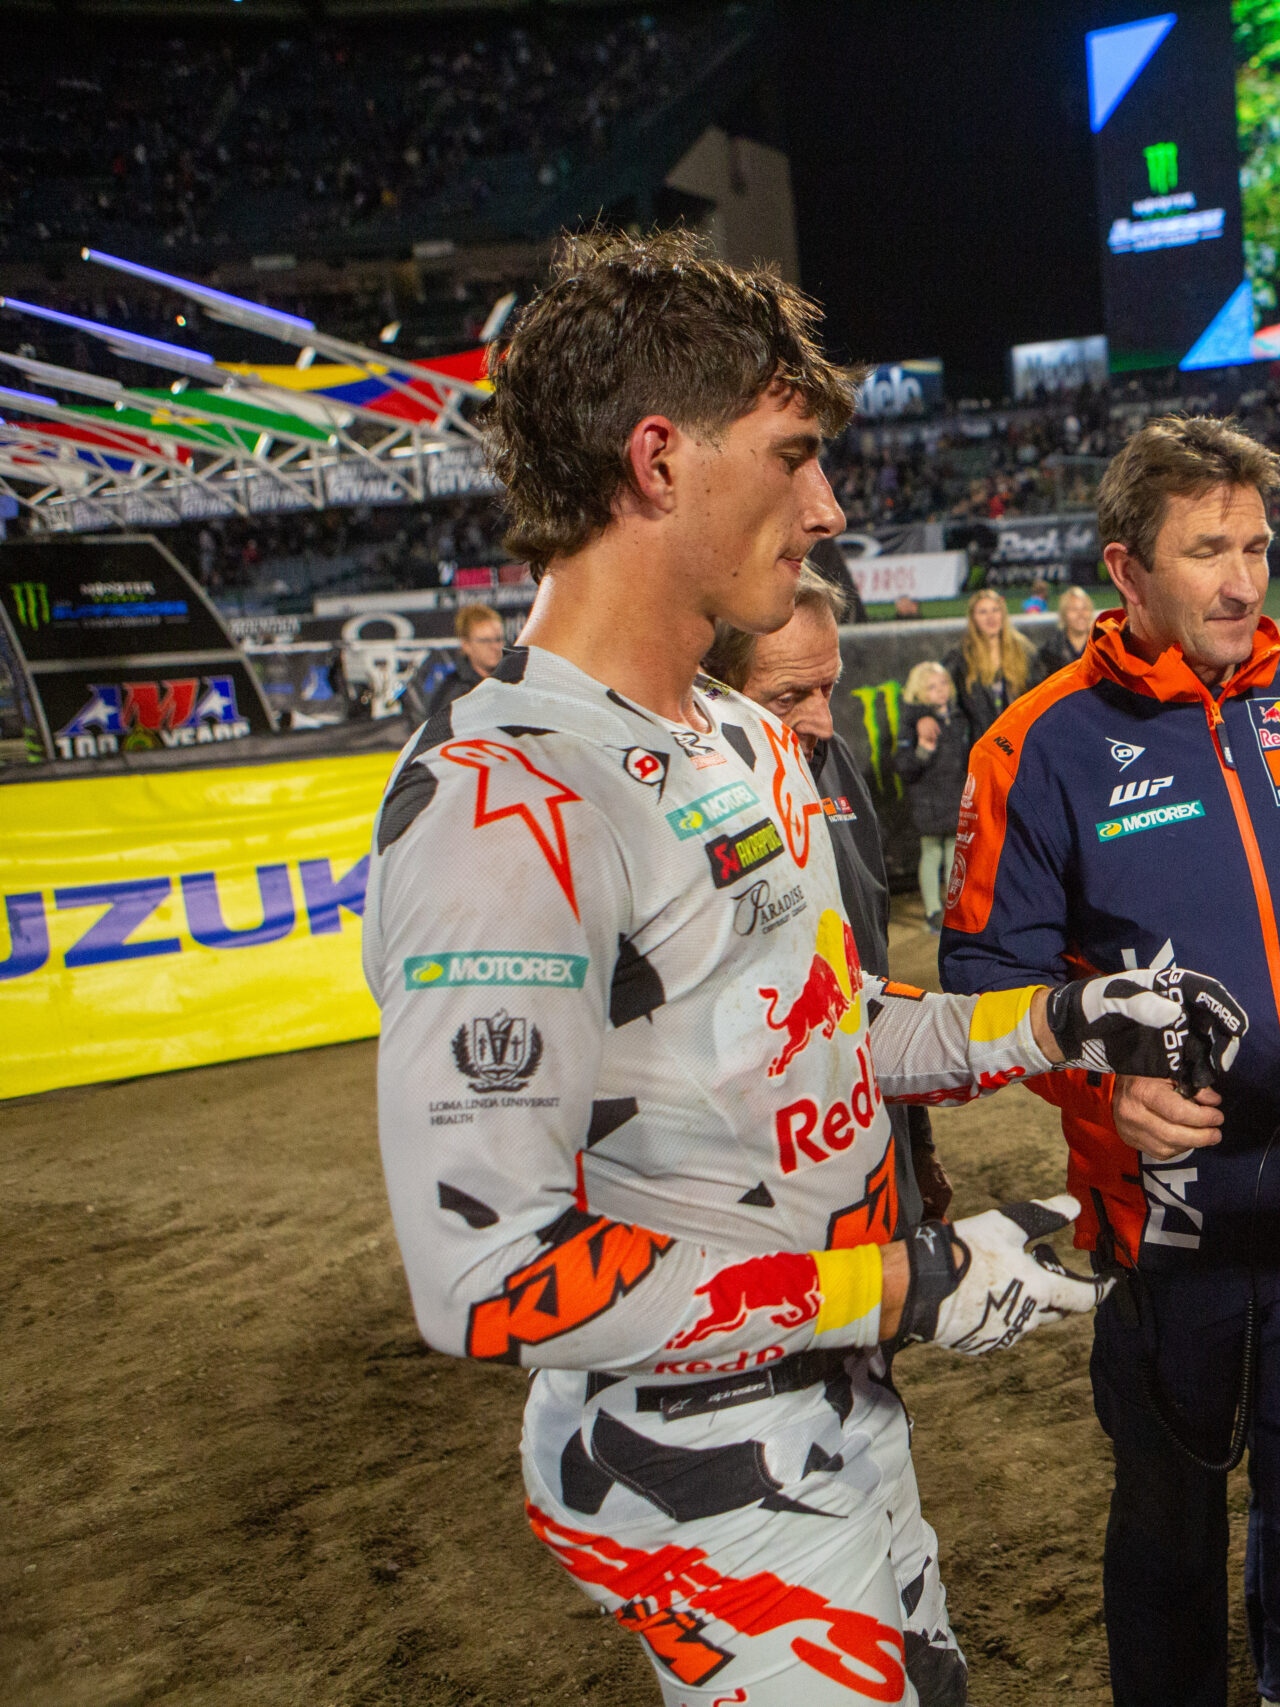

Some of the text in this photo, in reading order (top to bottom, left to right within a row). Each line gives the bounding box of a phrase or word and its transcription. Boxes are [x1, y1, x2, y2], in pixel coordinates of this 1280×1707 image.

[54, 675, 250, 735] AMA
[993, 735, 1015, 757] KTM
[700, 785, 754, 822] MOTOREX
[1109, 775, 1174, 807] WP
[1122, 801, 1200, 832] MOTOREX
[448, 956, 575, 984] MOTOREX
[1195, 991, 1241, 1032] ASTARS
[429, 1101, 463, 1113] LOMA
[501, 1097, 560, 1108] UNIVERSIT
[431, 1113, 474, 1126] HEALTH
[775, 1046, 875, 1175] Red
